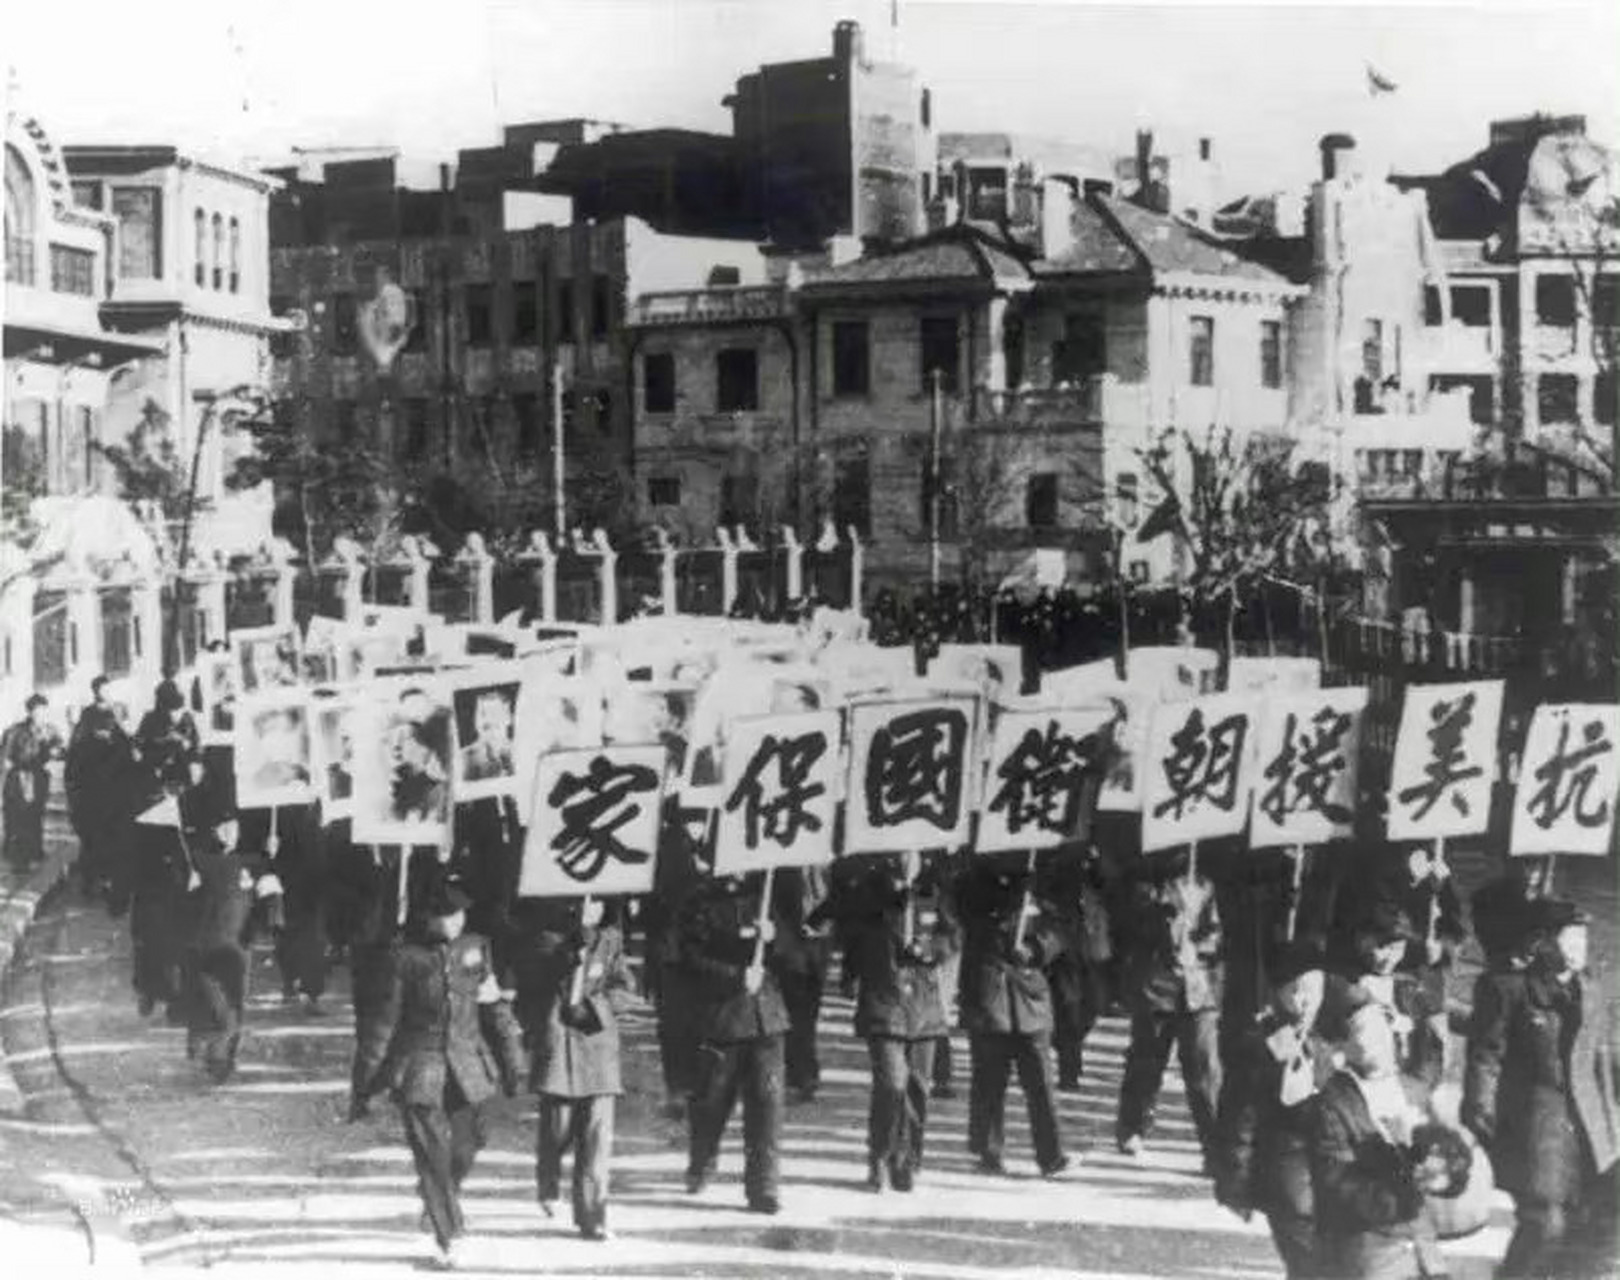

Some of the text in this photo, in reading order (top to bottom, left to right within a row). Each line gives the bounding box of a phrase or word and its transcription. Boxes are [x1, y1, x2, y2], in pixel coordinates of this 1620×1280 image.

[725, 731, 826, 849] 保
[866, 708, 966, 831] 國
[1154, 709, 1248, 820] 朝
[1260, 707, 1353, 825] 援
[1399, 693, 1483, 821] 美
[1526, 721, 1612, 829] 抗
[548, 755, 659, 882] 家
